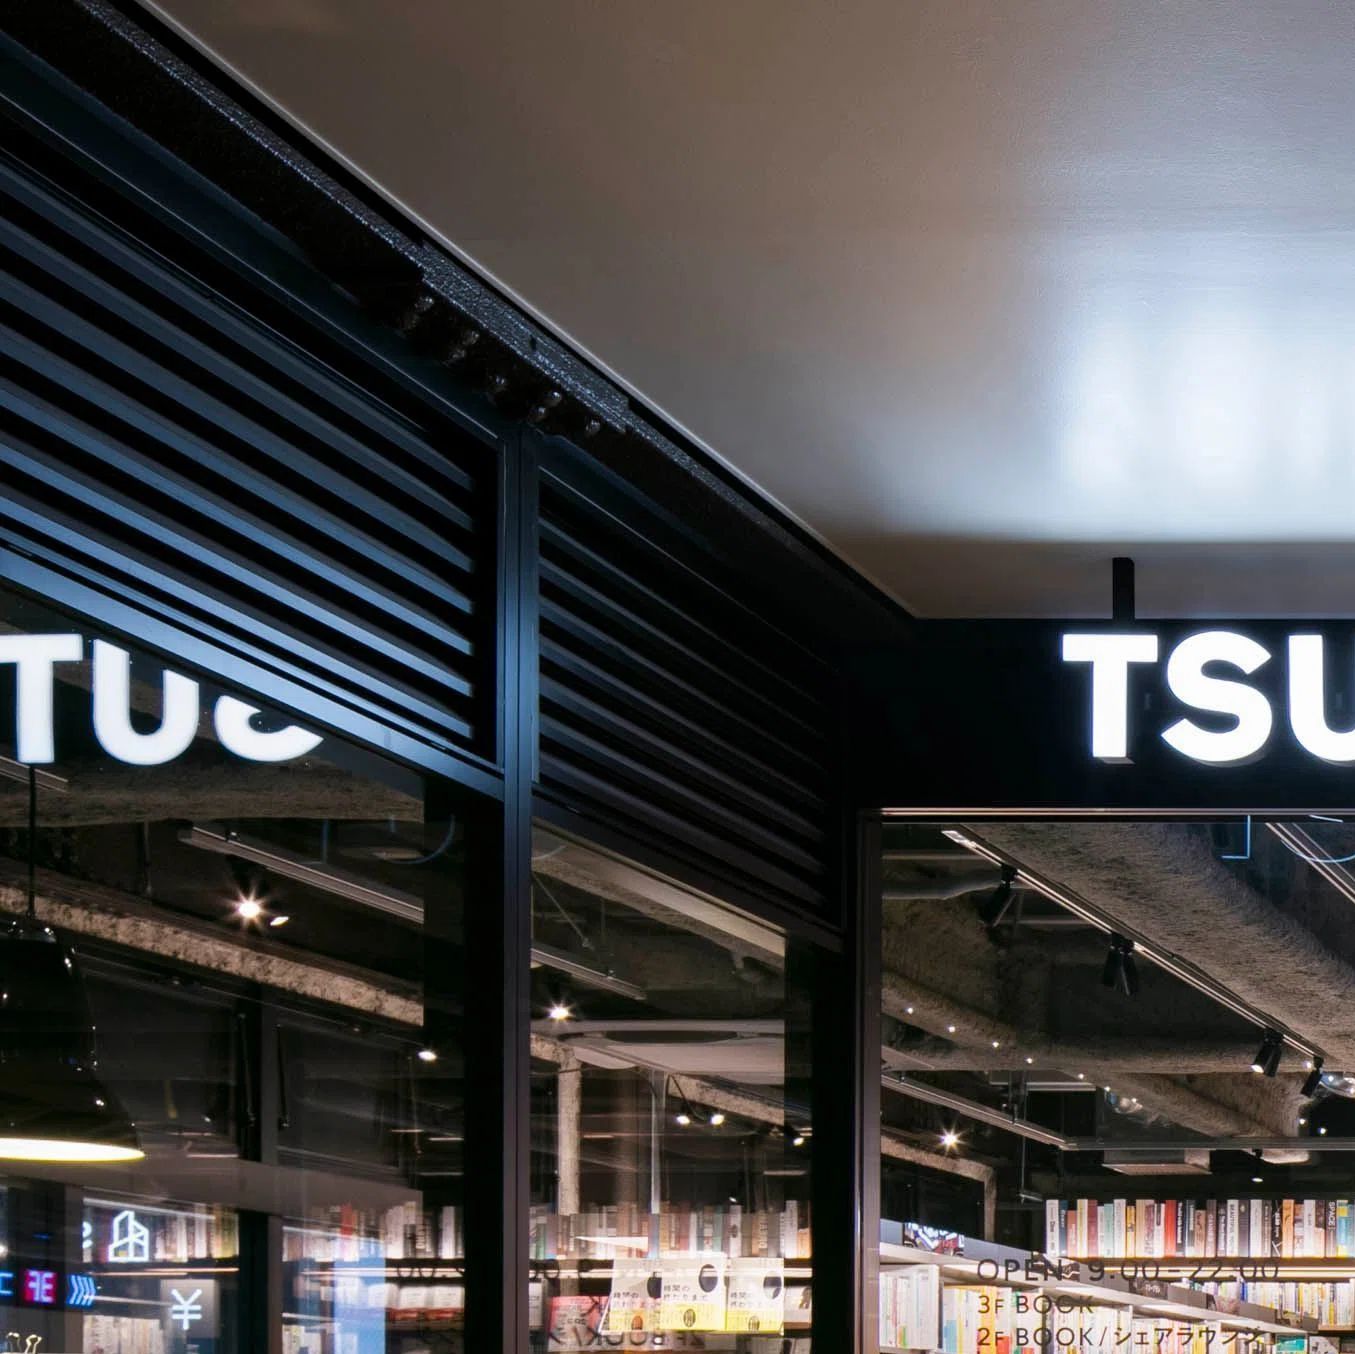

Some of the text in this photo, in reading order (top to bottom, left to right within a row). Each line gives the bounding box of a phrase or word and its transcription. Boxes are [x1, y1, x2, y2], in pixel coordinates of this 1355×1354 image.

[977, 1258, 1064, 1282] OPEN
[977, 1295, 1094, 1314] 3F BOOK
[977, 1327, 1005, 1346] 2F
